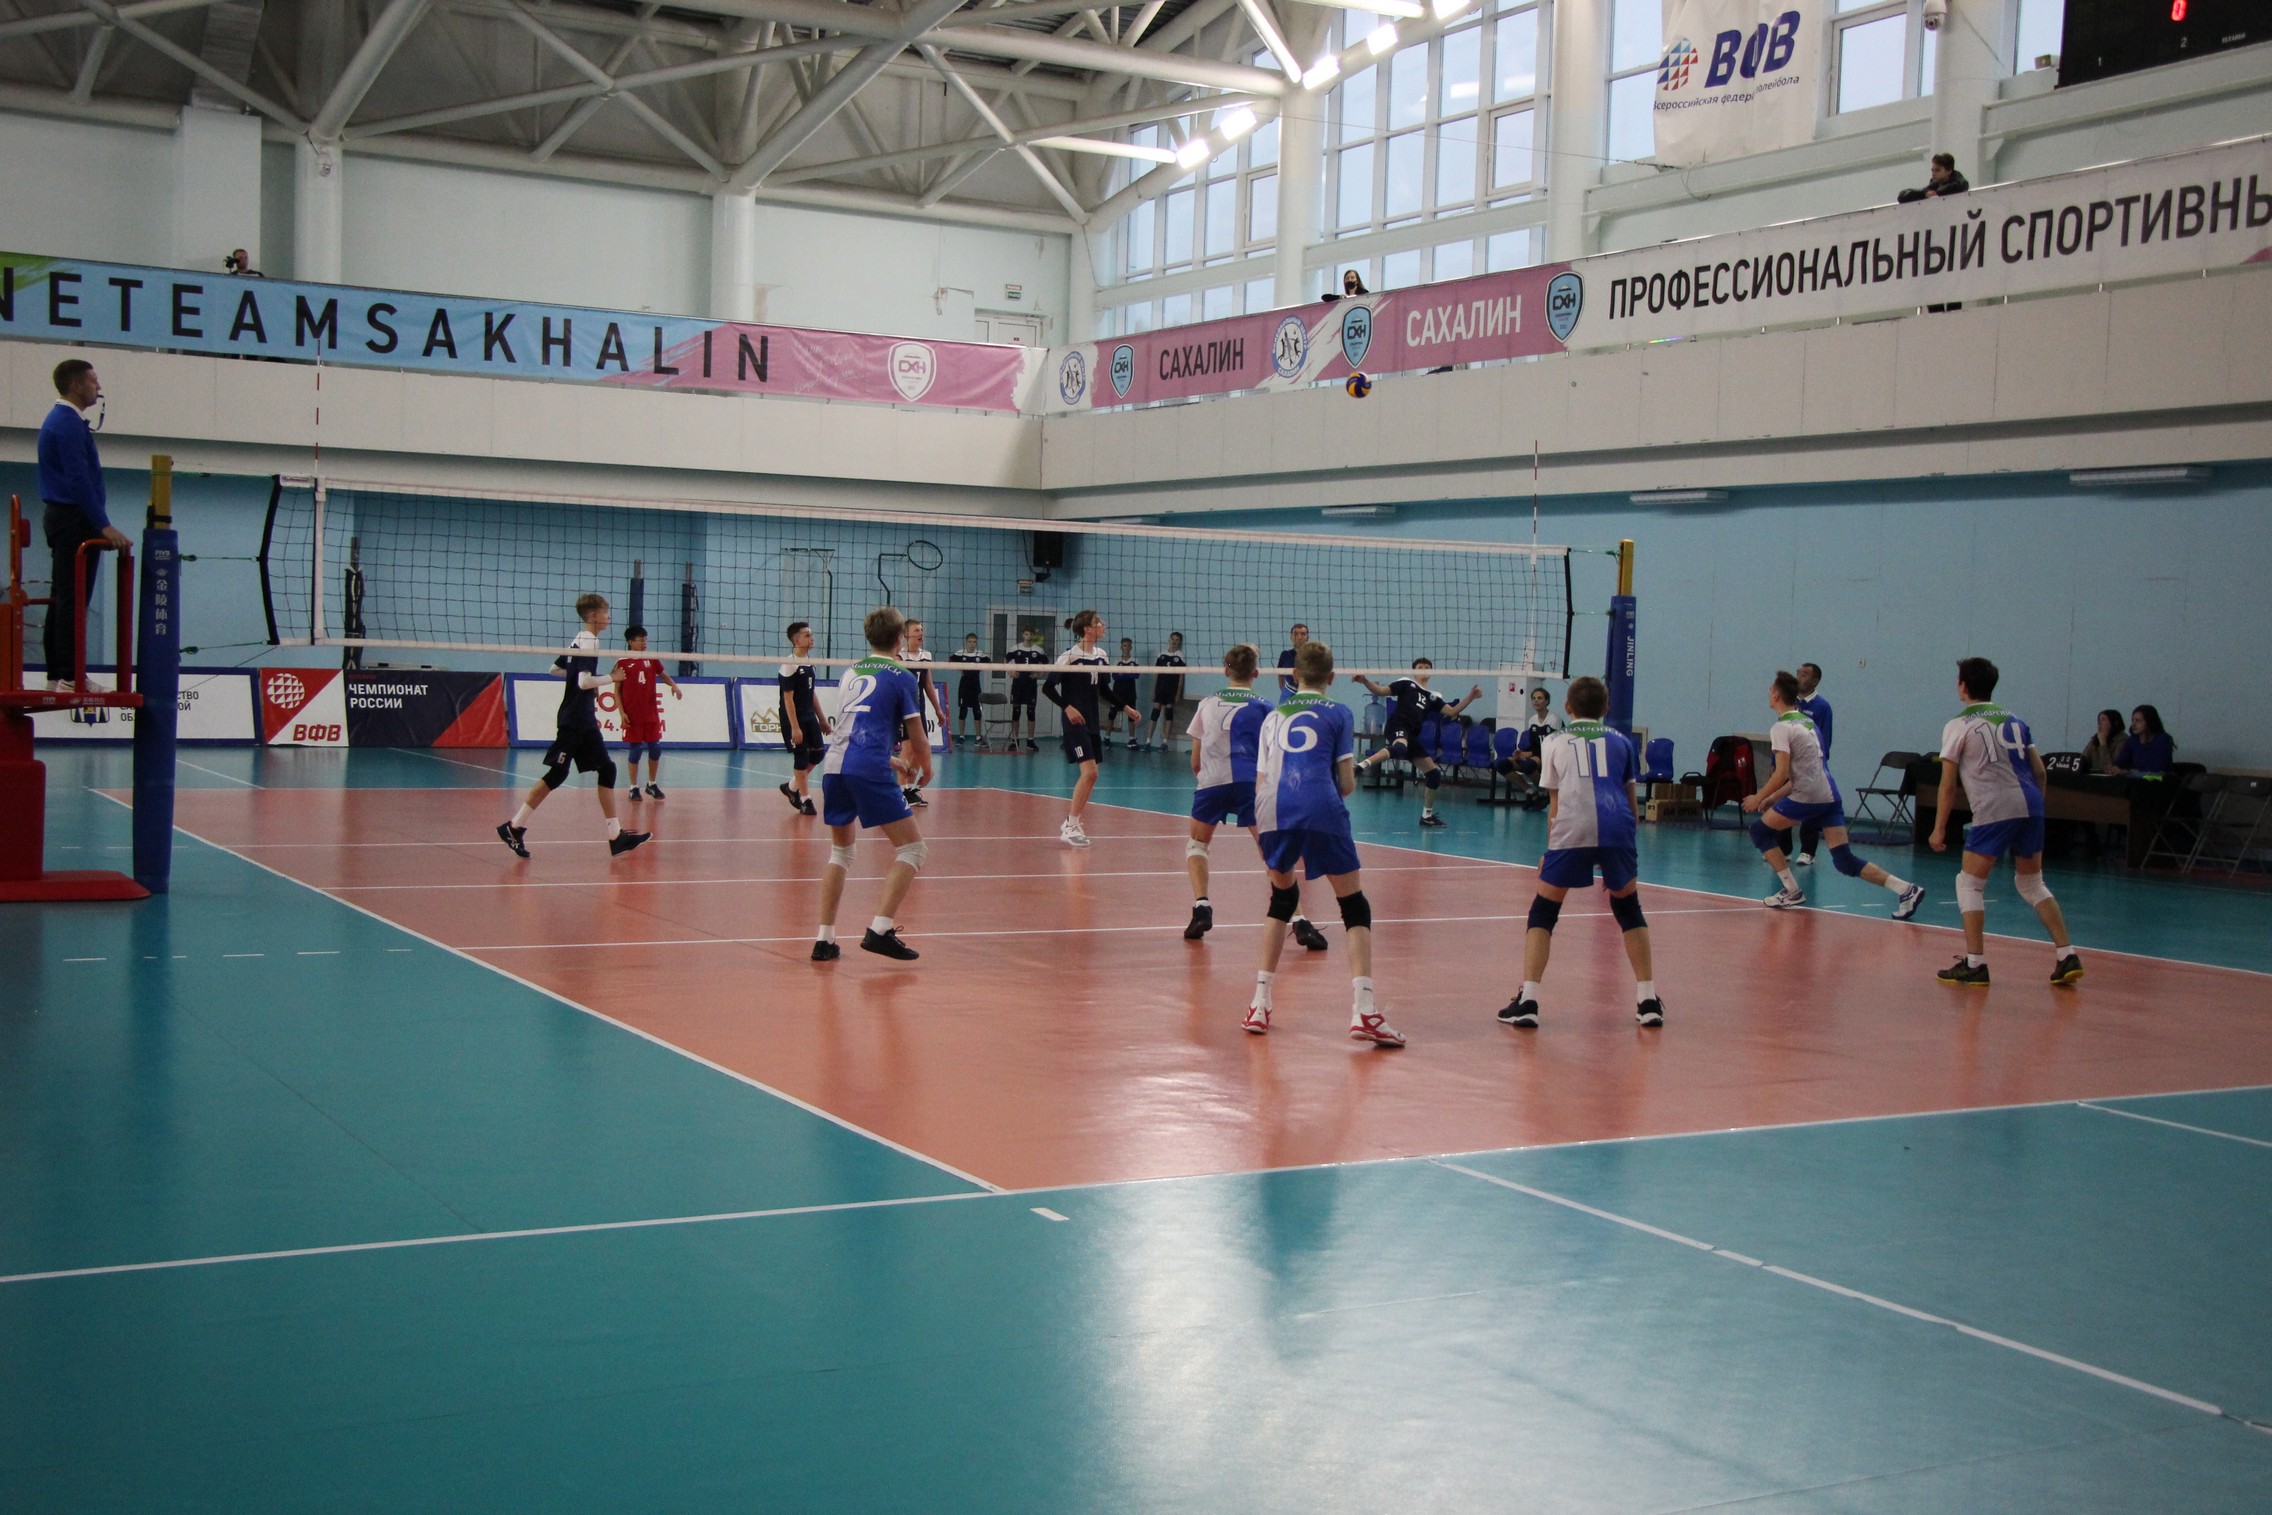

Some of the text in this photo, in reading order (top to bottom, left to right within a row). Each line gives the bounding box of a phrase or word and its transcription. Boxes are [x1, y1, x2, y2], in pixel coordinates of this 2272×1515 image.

[1609, 208, 1986, 320] ПРОФЕССИОНАЛЬНЫЙ
[1406, 294, 1521, 347] САХАЛИН
[1160, 338, 1244, 380] САХАЛИН
[1626, 636, 1634, 677] JINLING
[349, 684, 428, 695] ЧЕМПИОНАТ
[638, 670, 647, 685] 4
[844, 674, 877, 713] 2
[350, 697, 402, 709] РОССИИ
[1218, 701, 1249, 731] 7
[293, 724, 341, 741] ВФВ
[1974, 721, 2026, 764] 14
[557, 752, 567, 764] 6
[1568, 736, 1608, 777] 11
[2047, 757, 2056, 770] 2
[2072, 758, 2081, 771] 5
